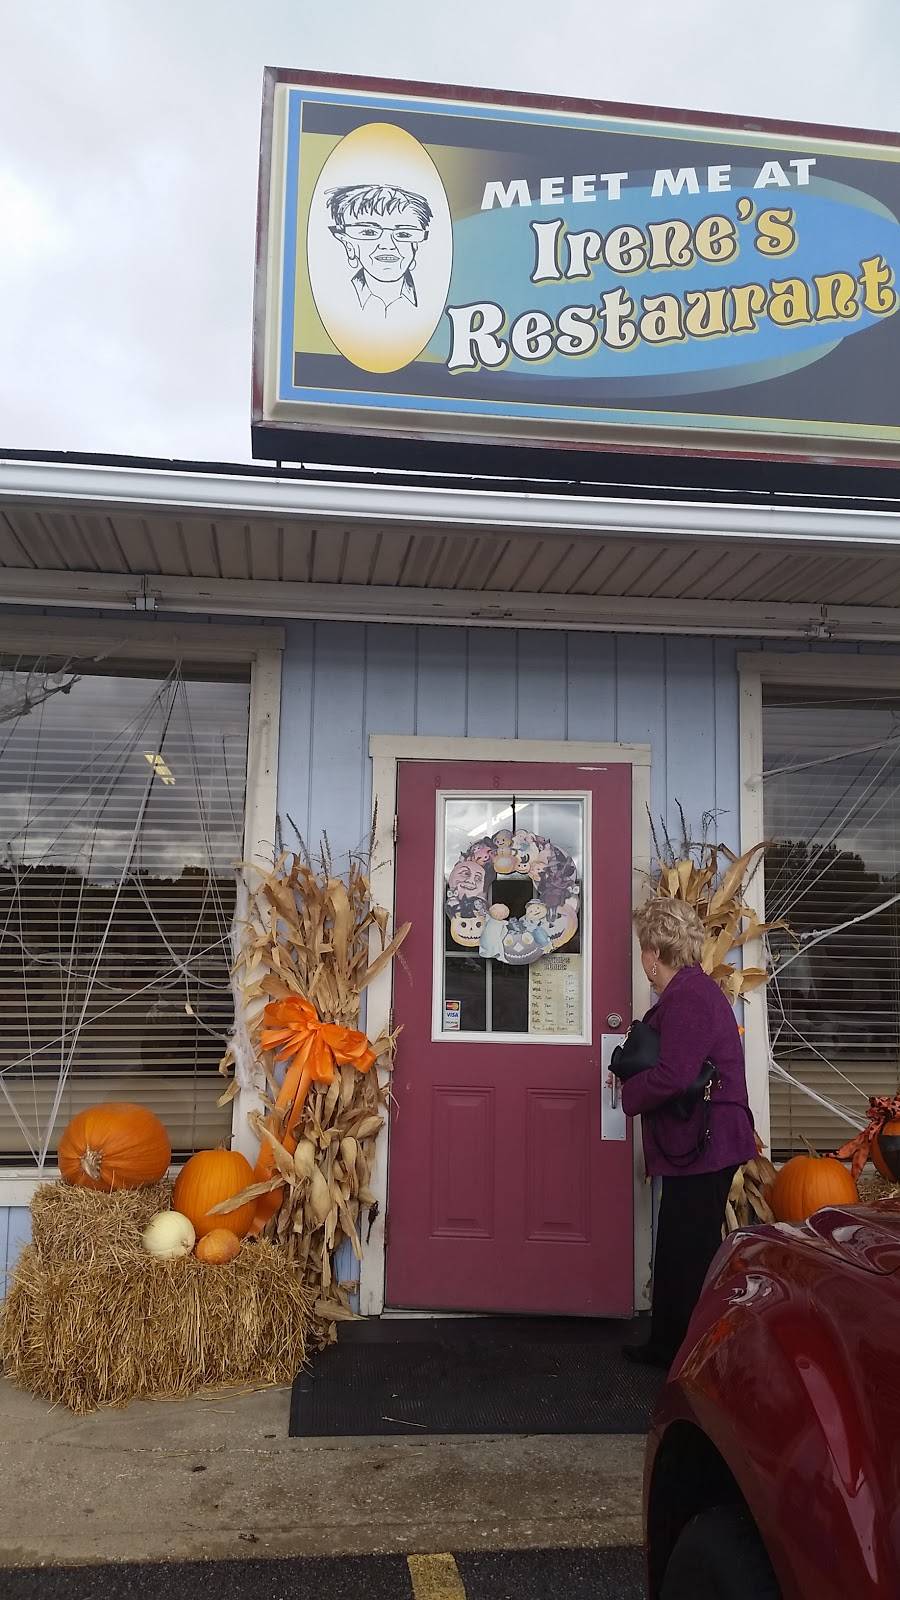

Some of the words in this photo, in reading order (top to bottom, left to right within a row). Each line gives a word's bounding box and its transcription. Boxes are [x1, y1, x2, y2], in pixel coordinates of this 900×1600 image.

[480, 172, 628, 210] MEET
[651, 164, 732, 197] ME
[753, 158, 817, 189] AT
[530, 196, 797, 285] Irene's
[446, 255, 898, 374] Restaurant
